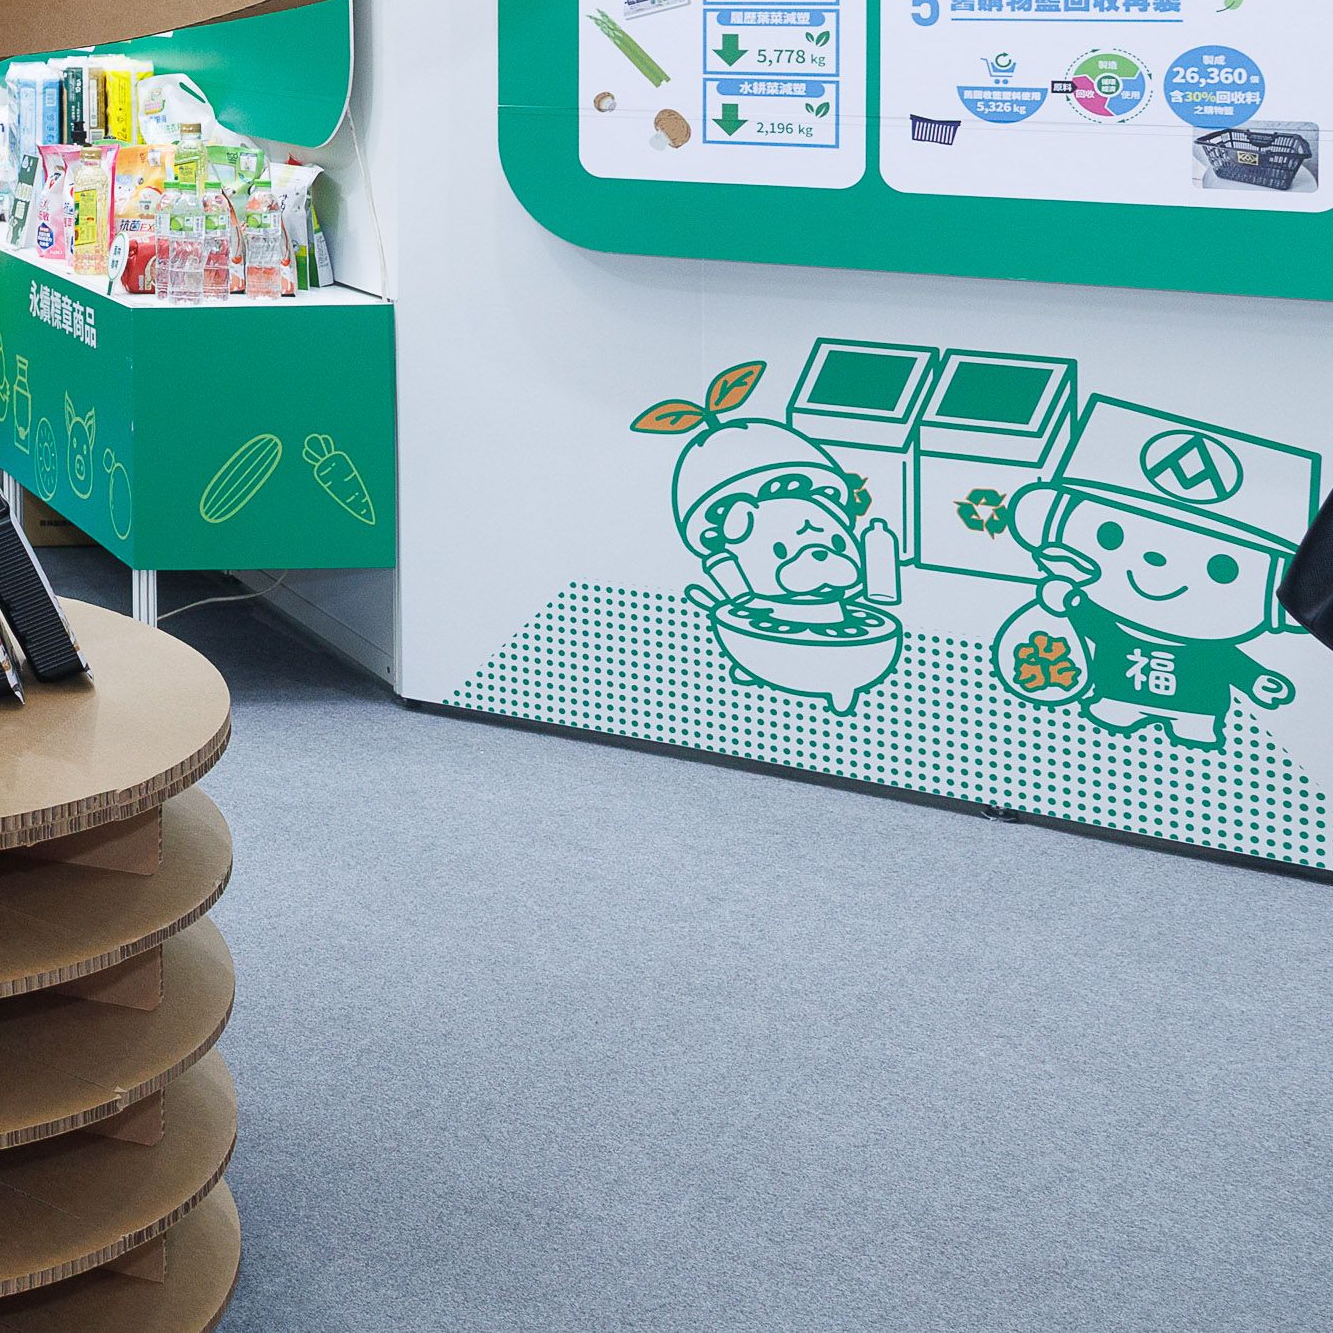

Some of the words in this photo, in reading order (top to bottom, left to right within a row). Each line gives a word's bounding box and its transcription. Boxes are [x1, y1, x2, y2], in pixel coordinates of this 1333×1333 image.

[757, 49, 806, 66] 5,778
[811, 54, 826, 67] kg
[1172, 67, 1247, 87] 26,360
[1170, 90, 1261, 104] 含30%回收料
[976, 102, 1012, 115] 5,326
[1013, 103, 1026, 115] kg
[757, 122, 794, 136] 2,196
[799, 124, 813, 137] kg
[29, 280, 97, 349] 永續標章商品
[1126, 648, 1176, 695] 福
